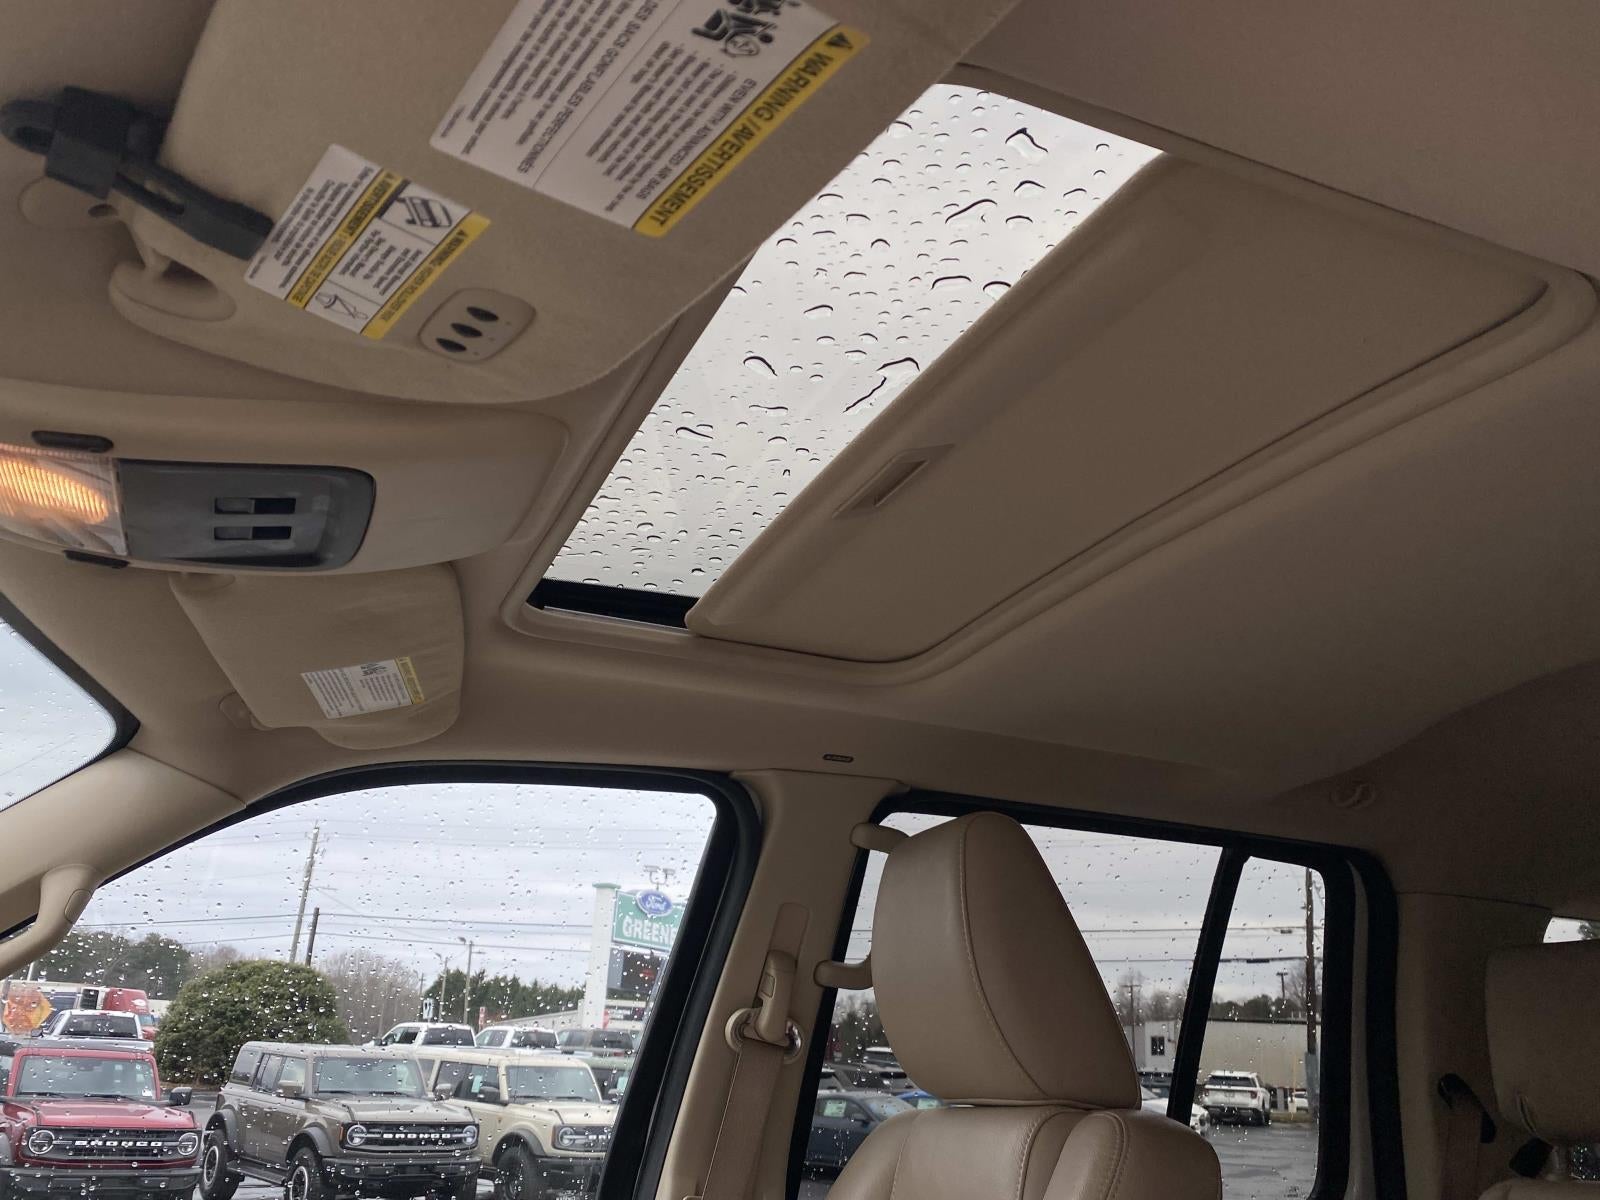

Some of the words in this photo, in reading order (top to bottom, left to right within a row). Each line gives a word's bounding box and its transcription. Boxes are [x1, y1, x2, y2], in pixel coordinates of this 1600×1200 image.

[726, 77, 758, 104] EVEN
[750, 49, 836, 121] WARNING
[666, 124, 713, 166] ADVANCED
[643, 123, 762, 226] AVERTISSEMENT
[74, 1138, 163, 1147] BRONCO
